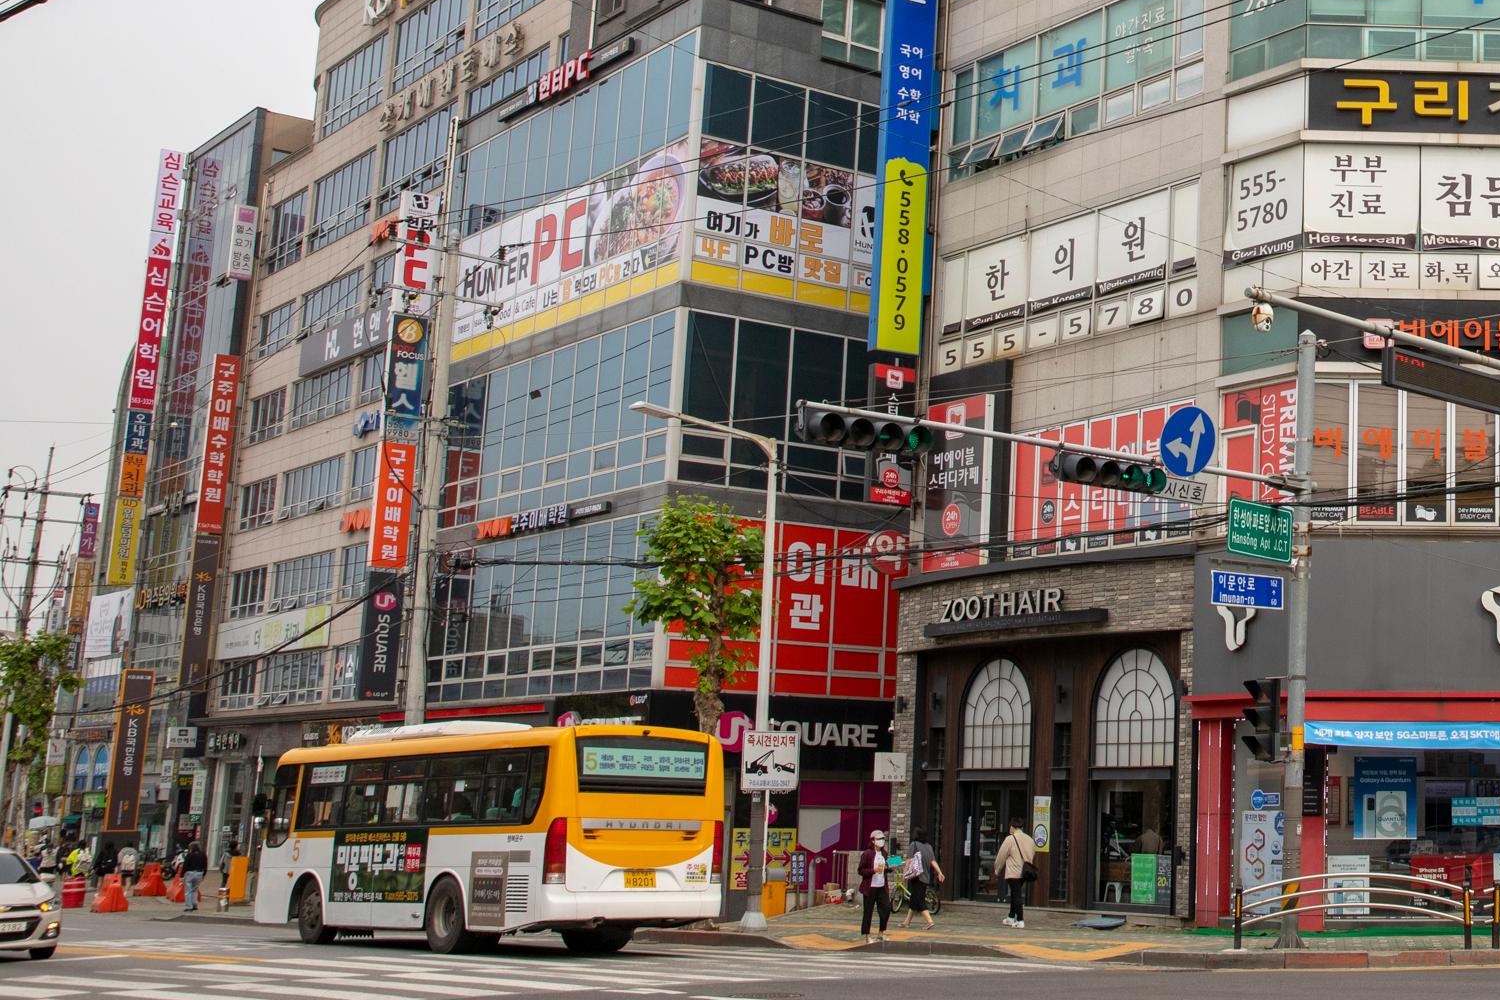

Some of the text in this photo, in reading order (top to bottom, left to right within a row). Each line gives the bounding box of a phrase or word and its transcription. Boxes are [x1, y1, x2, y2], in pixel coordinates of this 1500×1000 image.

[899, 44, 923, 59] 국어
[899, 64, 922, 80] 영어
[897, 87, 921, 103] 수학
[896, 108, 920, 125] 과학
[1329, 155, 1387, 183] 부부
[156, 151, 183, 231] 심슨교육
[1235, 197, 1289, 233] 5780
[1329, 190, 1387, 218] 진료
[707, 210, 823, 253] 여기가 바로
[1309, 233, 1340, 245] Hee
[463, 200, 586, 302] HUNTER PC
[702, 238, 841, 284] 4F 맛집
[985, 216, 1146, 302] 한의원
[1311, 260, 1353, 281] 야간
[1368, 260, 1410, 282] 진료
[1425, 261, 1473, 284] 화,목
[543, 290, 558, 309] 나는
[135, 266, 168, 390] 심슨어학원
[397, 351, 424, 361] FOCUS
[131, 413, 146, 450] 오내과
[205, 362, 235, 503] 구주이배수학학원
[124, 455, 144, 467] 부부
[934, 447, 974, 470] 비에이블
[928, 465, 979, 490] 스터디카페
[381, 448, 406, 562] 구주이배학원
[945, 510, 958, 522] 24h
[81, 523, 94, 551] 요가
[1260, 537, 1270, 551] Apt
[876, 534, 905, 570] 약
[1219, 575, 1255, 592] 이문안로
[939, 593, 999, 623] ZOOT
[1000, 587, 1063, 616] HAIR
[1219, 592, 1254, 605] Imunan-ro
[789, 593, 824, 630] 관
[373, 614, 390, 673] SQUARE
[747, 735, 796, 747] 즉시견인지역
[1375, 729, 1393, 740] 보안
[1450, 730, 1468, 740] 오직
[124, 719, 138, 776] KB국민은행
[586, 752, 597, 770] 5
[605, 821, 682, 829] HYUNDAI
[292, 839, 300, 862] 5
[735, 832, 793, 848] 주입구
